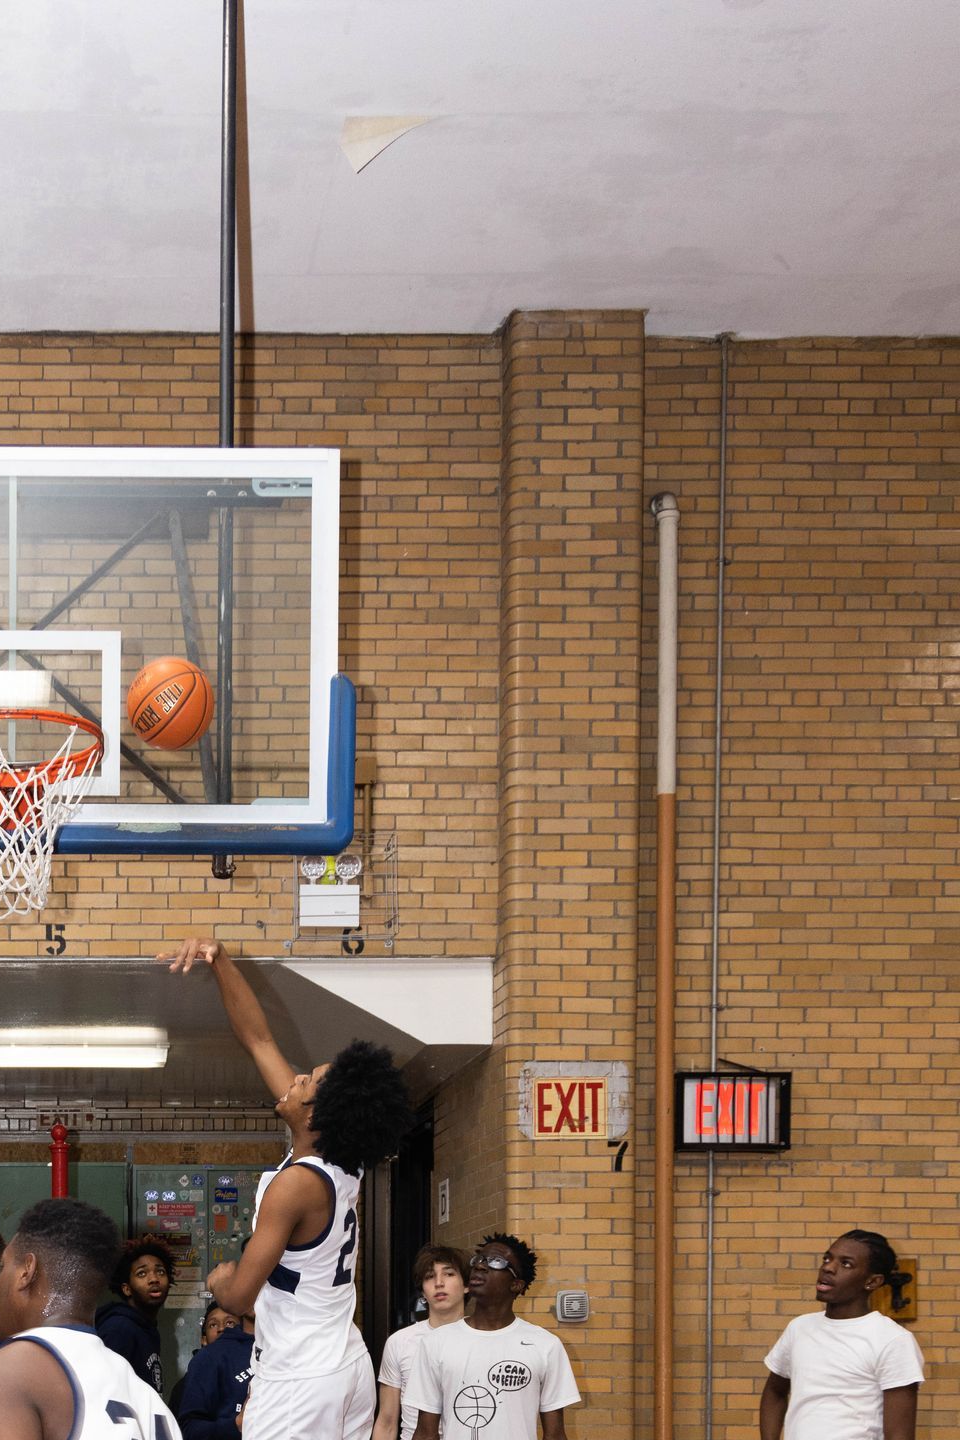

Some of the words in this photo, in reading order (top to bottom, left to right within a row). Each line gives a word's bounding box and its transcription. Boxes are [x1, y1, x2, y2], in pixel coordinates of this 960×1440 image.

[154, 682, 184, 715] THE
[135, 703, 162, 735] ROCK
[45, 924, 66, 955] 5
[342, 926, 365, 955] 6
[537, 1083, 603, 1133] EXIT
[695, 1083, 765, 1136] EXIT
[608, 1141, 628, 1172] 7
[492, 1374, 500, 1384] DO
[504, 1365, 526, 1375] CAN
